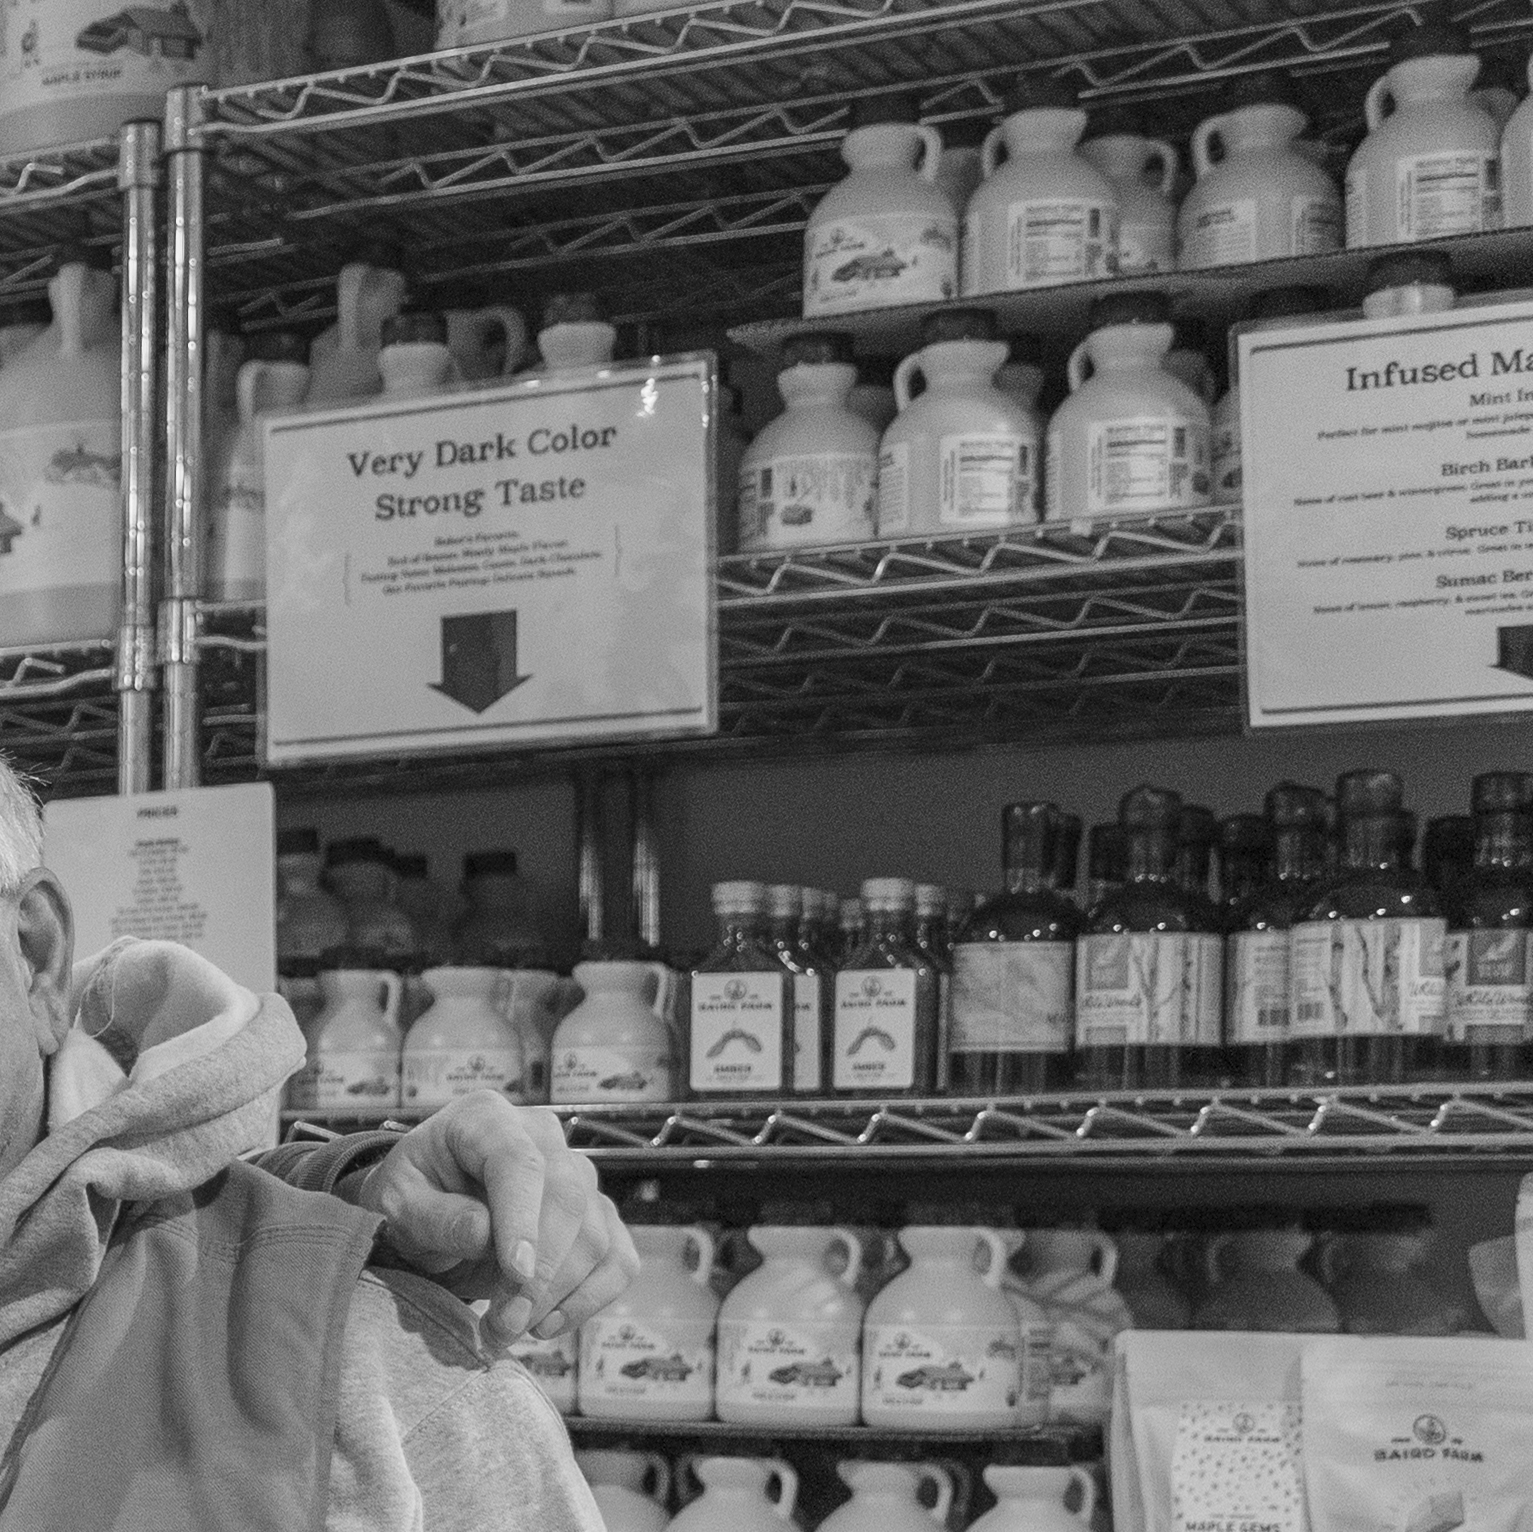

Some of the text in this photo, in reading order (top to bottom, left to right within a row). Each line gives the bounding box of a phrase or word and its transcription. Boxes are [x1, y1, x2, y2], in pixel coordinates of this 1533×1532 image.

[1346, 352, 1480, 391] Infused
[1469, 391, 1511, 407] Mint
[348, 424, 617, 479] Very Dark Color
[1441, 461, 1490, 477] Birch
[375, 476, 586, 520] Strong Taste
[1446, 525, 1508, 541] Spruce
[1436, 574, 1497, 589] Sumac
[1374, 1448, 1484, 1463] BAIRD FARM
